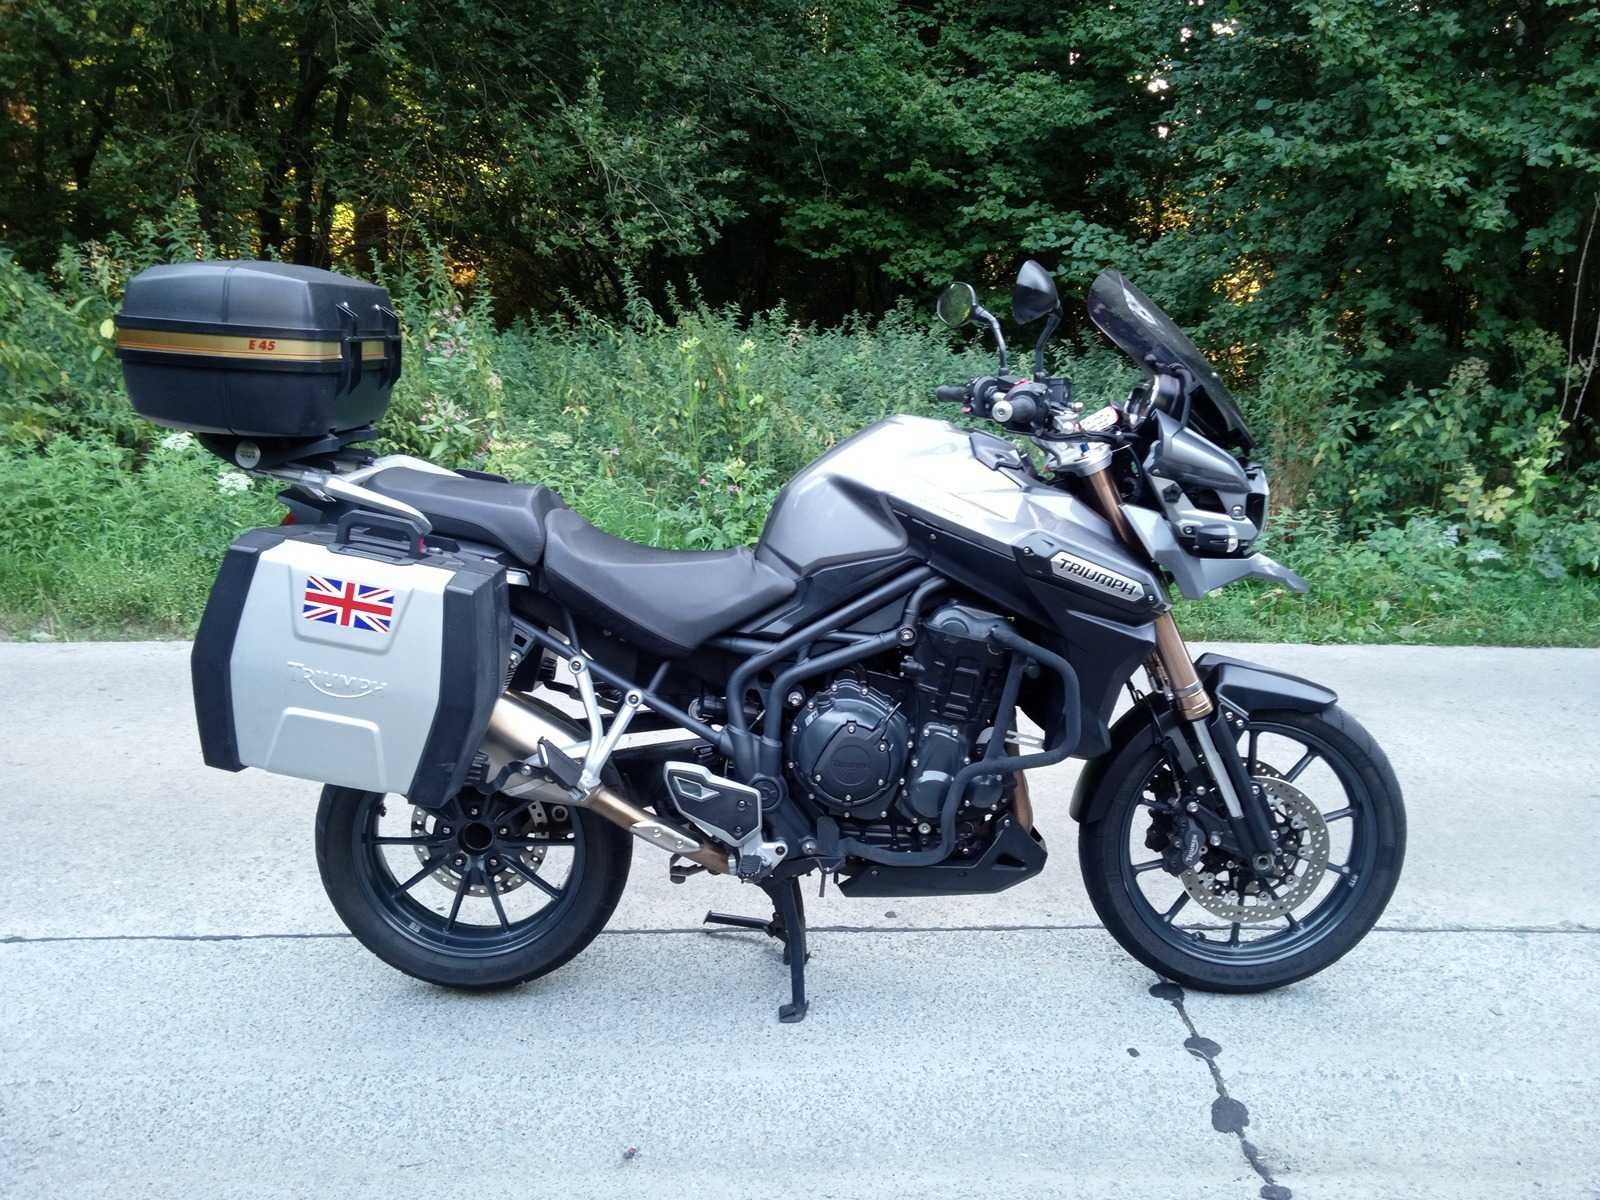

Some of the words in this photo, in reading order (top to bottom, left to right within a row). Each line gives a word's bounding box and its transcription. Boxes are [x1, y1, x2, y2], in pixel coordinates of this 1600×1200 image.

[248, 339, 256, 350] E
[258, 340, 277, 351] 45
[1060, 558, 1137, 595] TRIUMPH
